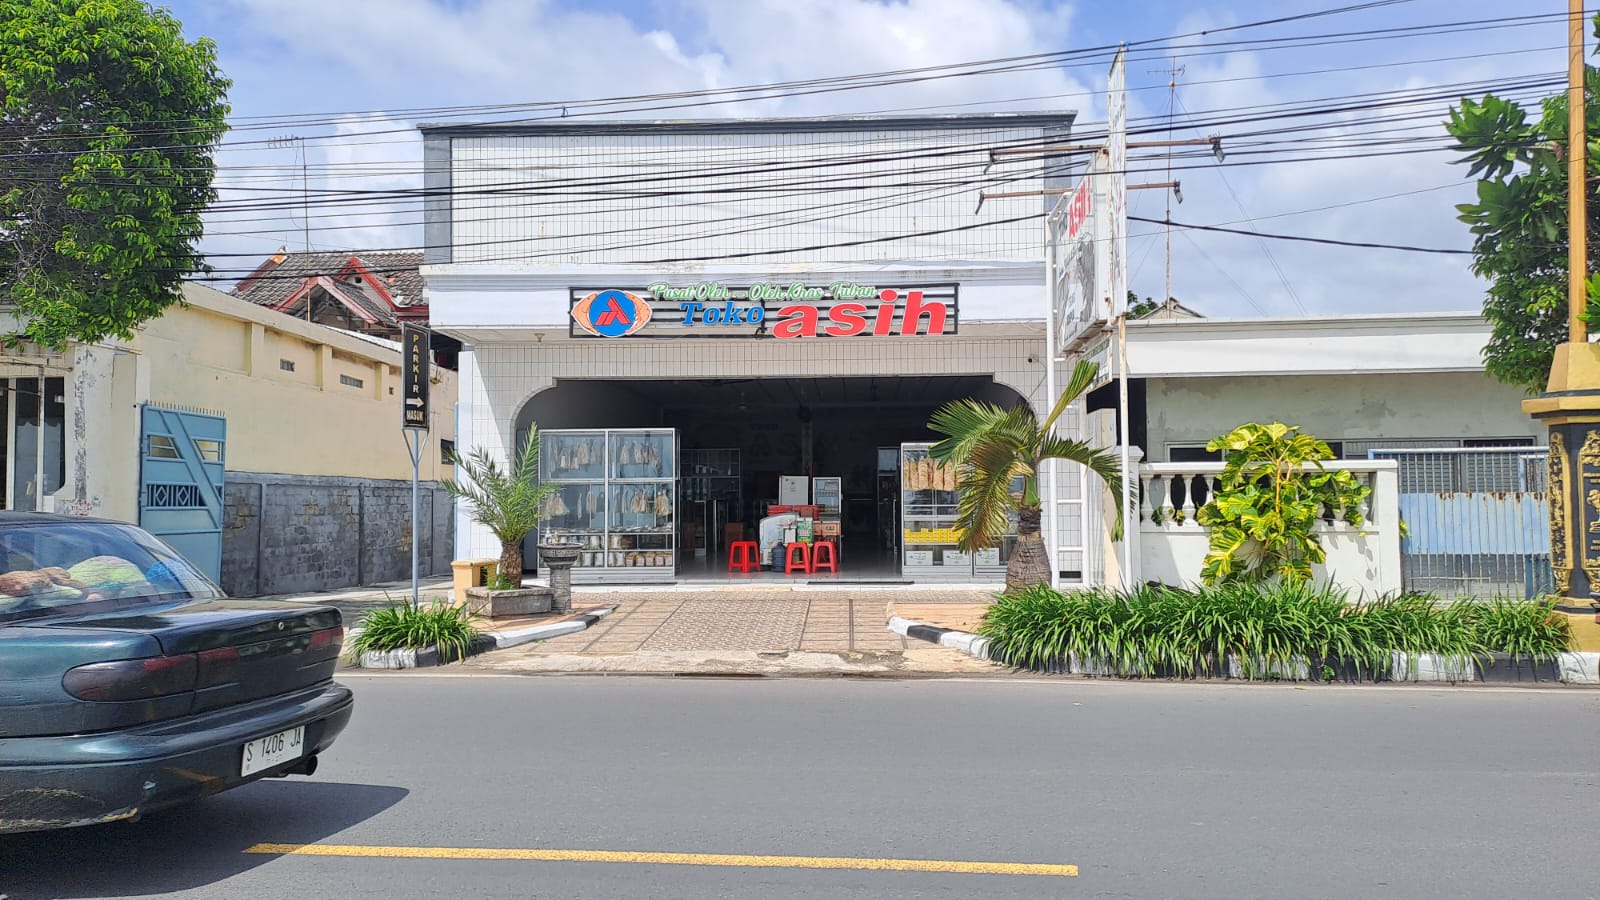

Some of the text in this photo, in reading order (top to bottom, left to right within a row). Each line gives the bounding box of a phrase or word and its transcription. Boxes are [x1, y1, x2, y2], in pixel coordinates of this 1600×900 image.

[648, 282, 695, 300] Pusat
[695, 281, 731, 299] Oleh
[749, 282, 785, 300] Oleh
[786, 282, 825, 300] Khas
[829, 281, 878, 299] Tuban
[680, 289, 947, 339] Toko asih
[412, 334, 420, 394] PARKIR
[406, 409, 424, 421] MASUK
[247, 728, 301, 762] S 1406 JA
